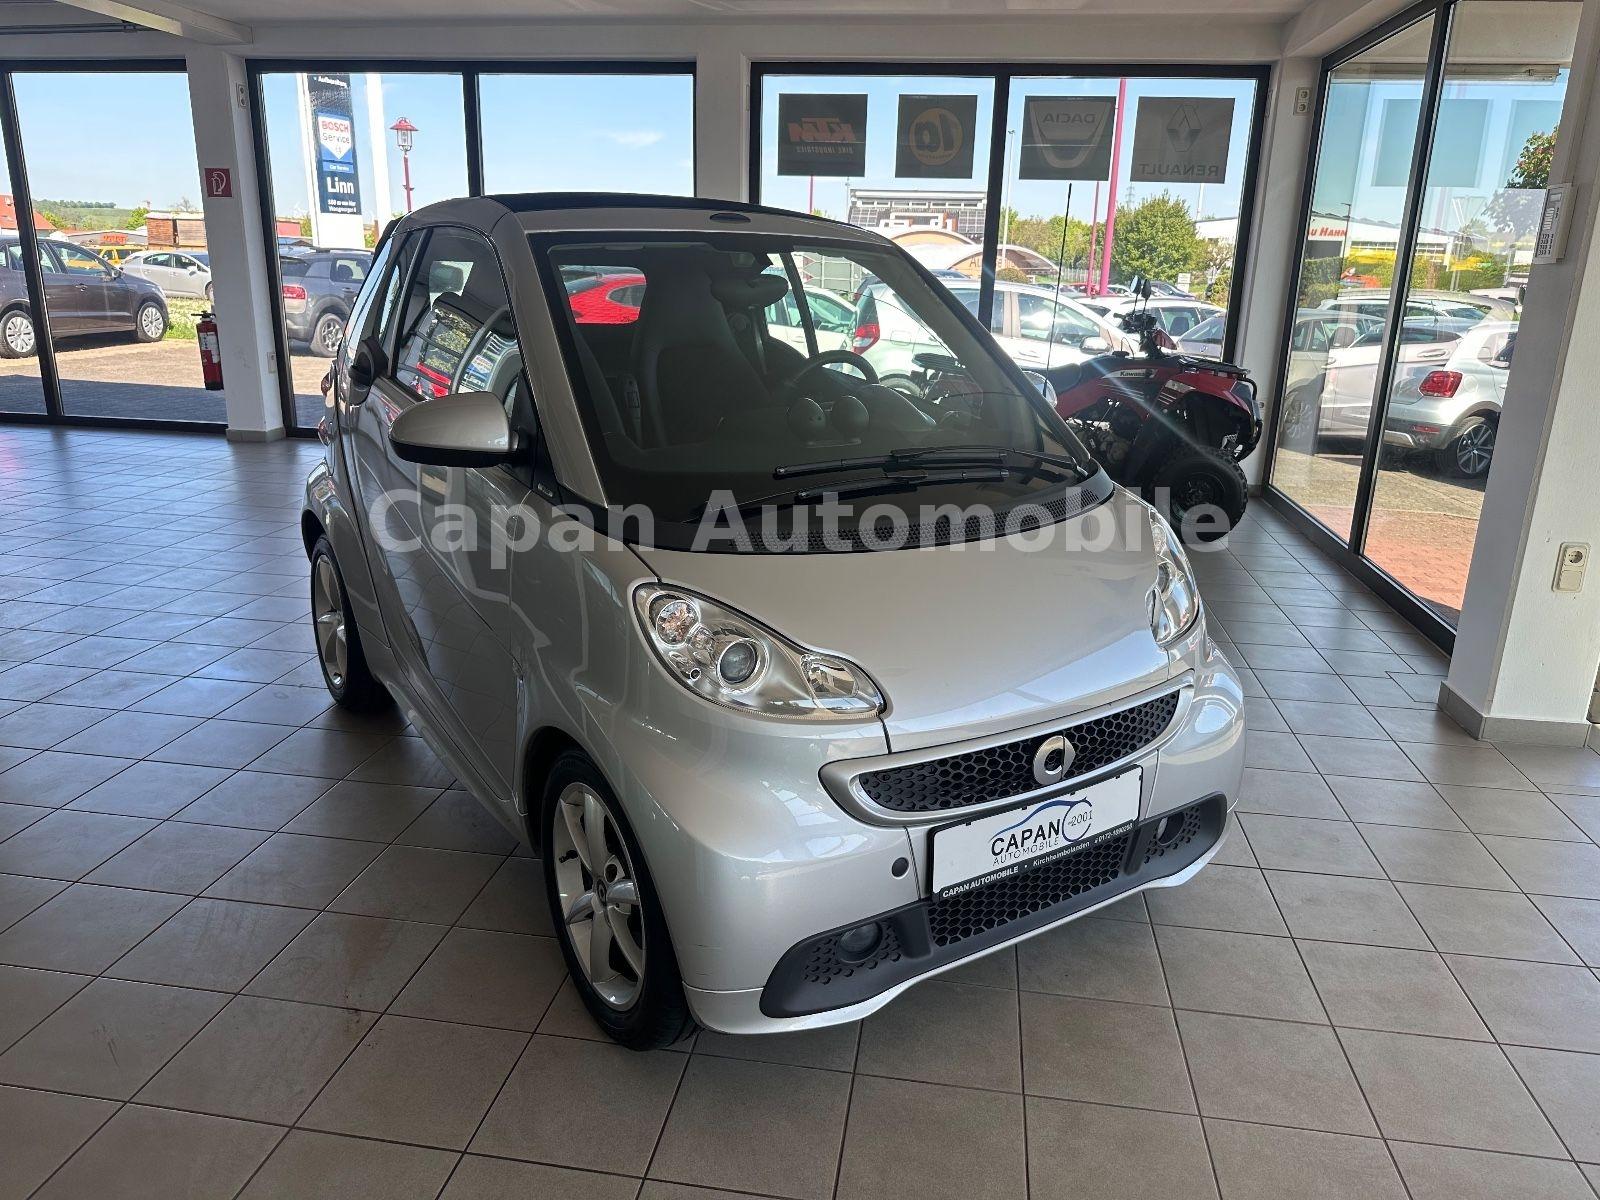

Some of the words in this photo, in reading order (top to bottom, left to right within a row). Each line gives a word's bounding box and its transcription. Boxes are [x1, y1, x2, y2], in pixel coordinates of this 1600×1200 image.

[321, 120, 349, 132] BOSCH
[322, 132, 350, 144] Service
[327, 177, 354, 194] Linn
[1071, 810, 1093, 827] 2001
[991, 818, 1060, 857] CAPAN
[993, 835, 1060, 867] AUTOMOBILE
[942, 884, 970, 898] CAPAN
[969, 866, 1019, 889] AUTOMOBILE
